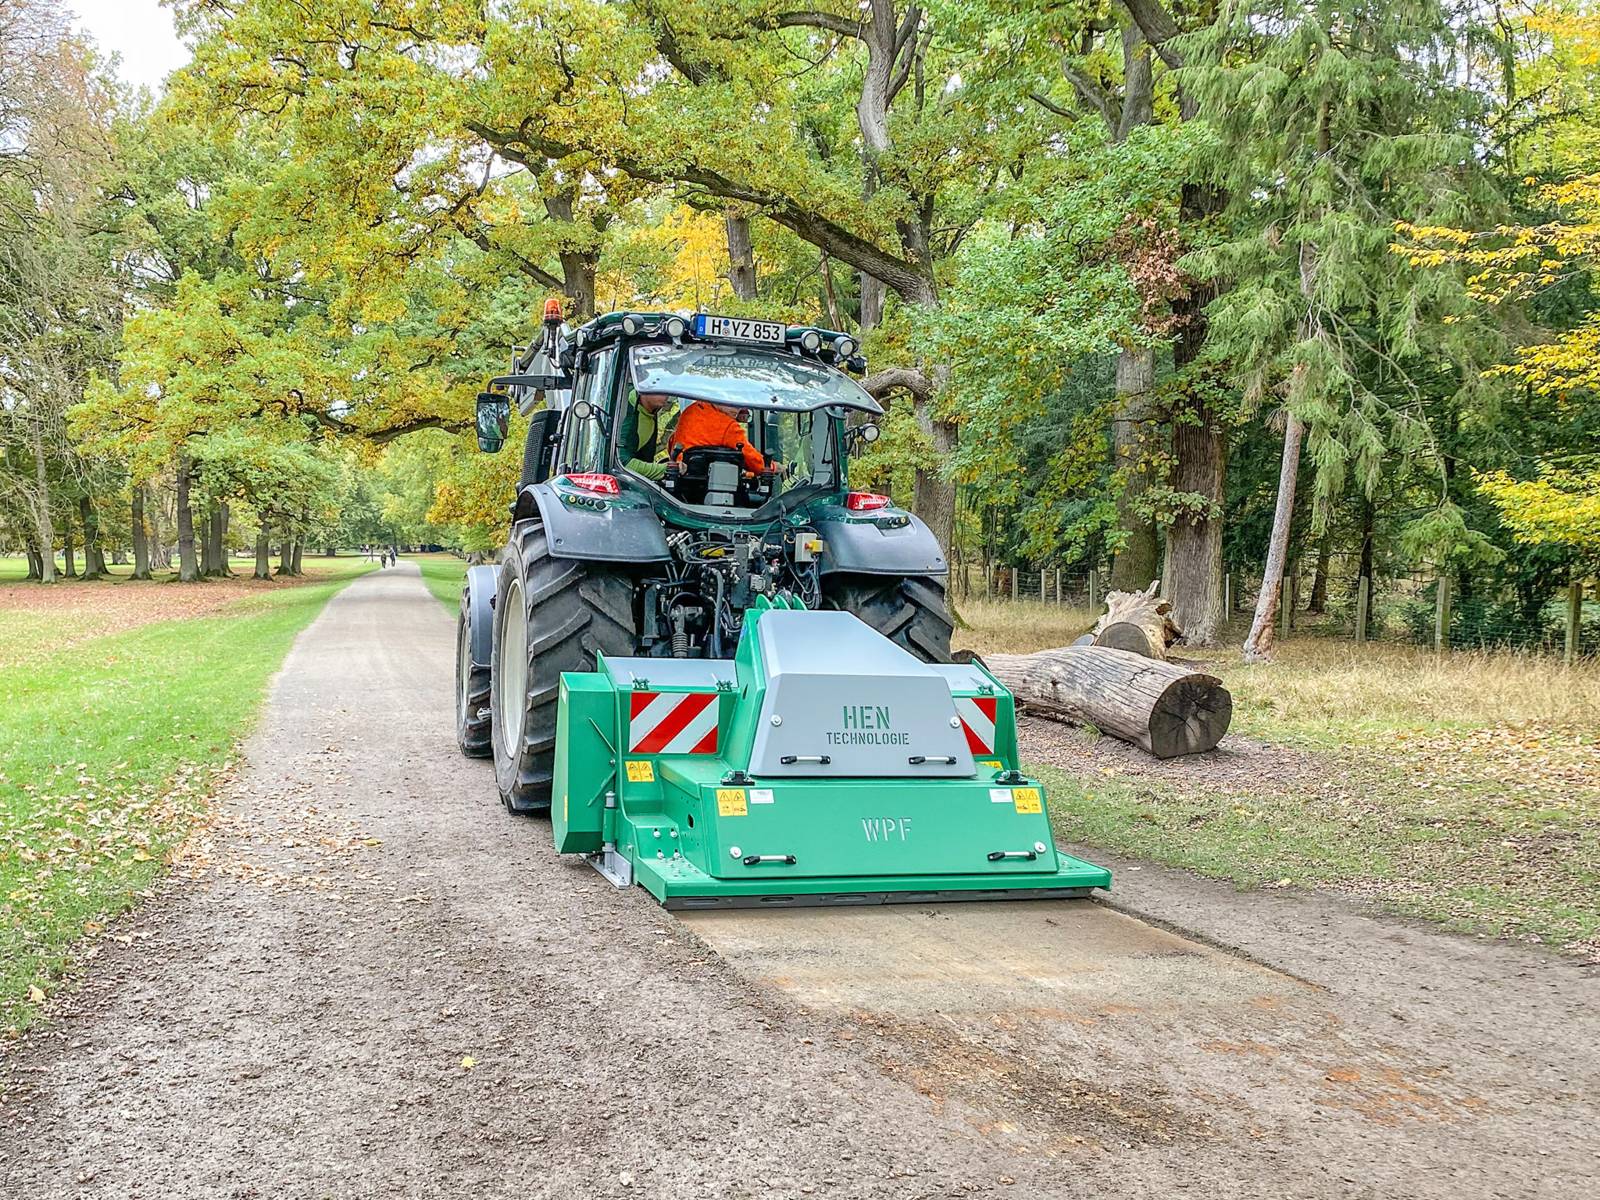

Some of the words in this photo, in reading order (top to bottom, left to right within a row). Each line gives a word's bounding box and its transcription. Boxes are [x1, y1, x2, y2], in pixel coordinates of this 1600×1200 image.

[712, 319, 722, 335] H
[732, 321, 750, 338] YZ
[754, 324, 780, 340] 853
[843, 706, 890, 729] HEN
[826, 732, 910, 744] TECHNOLOGIE
[862, 818, 912, 841] WPF
